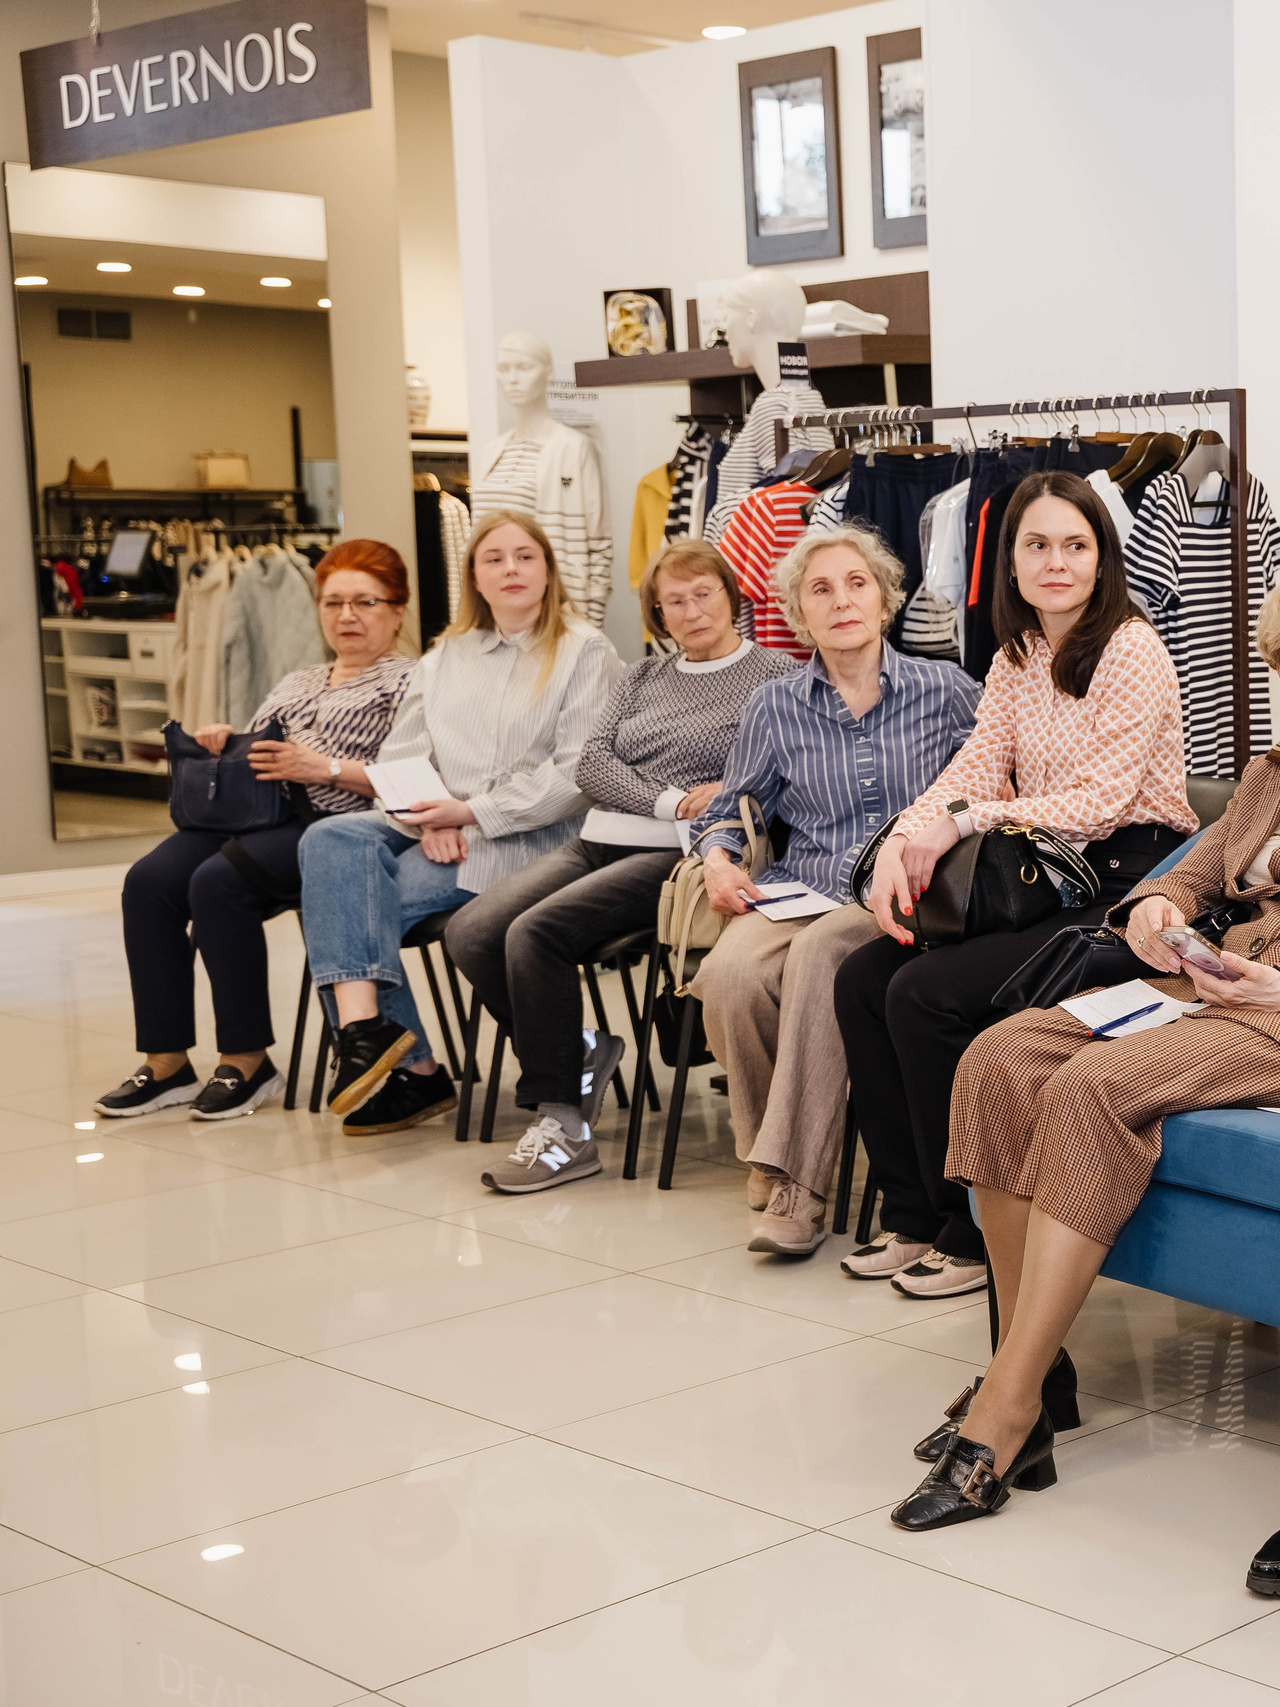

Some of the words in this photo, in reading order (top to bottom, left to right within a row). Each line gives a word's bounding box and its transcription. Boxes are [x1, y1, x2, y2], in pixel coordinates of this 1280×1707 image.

[59, 22, 318, 130] DEVERNOIS
[780, 355, 808, 366] НОВАЯ
[547, 391, 600, 402] ТРЕБИТЕЛЯ
[1053, 839, 1084, 869] COCCINELLE
[538, 1144, 571, 1172] N
